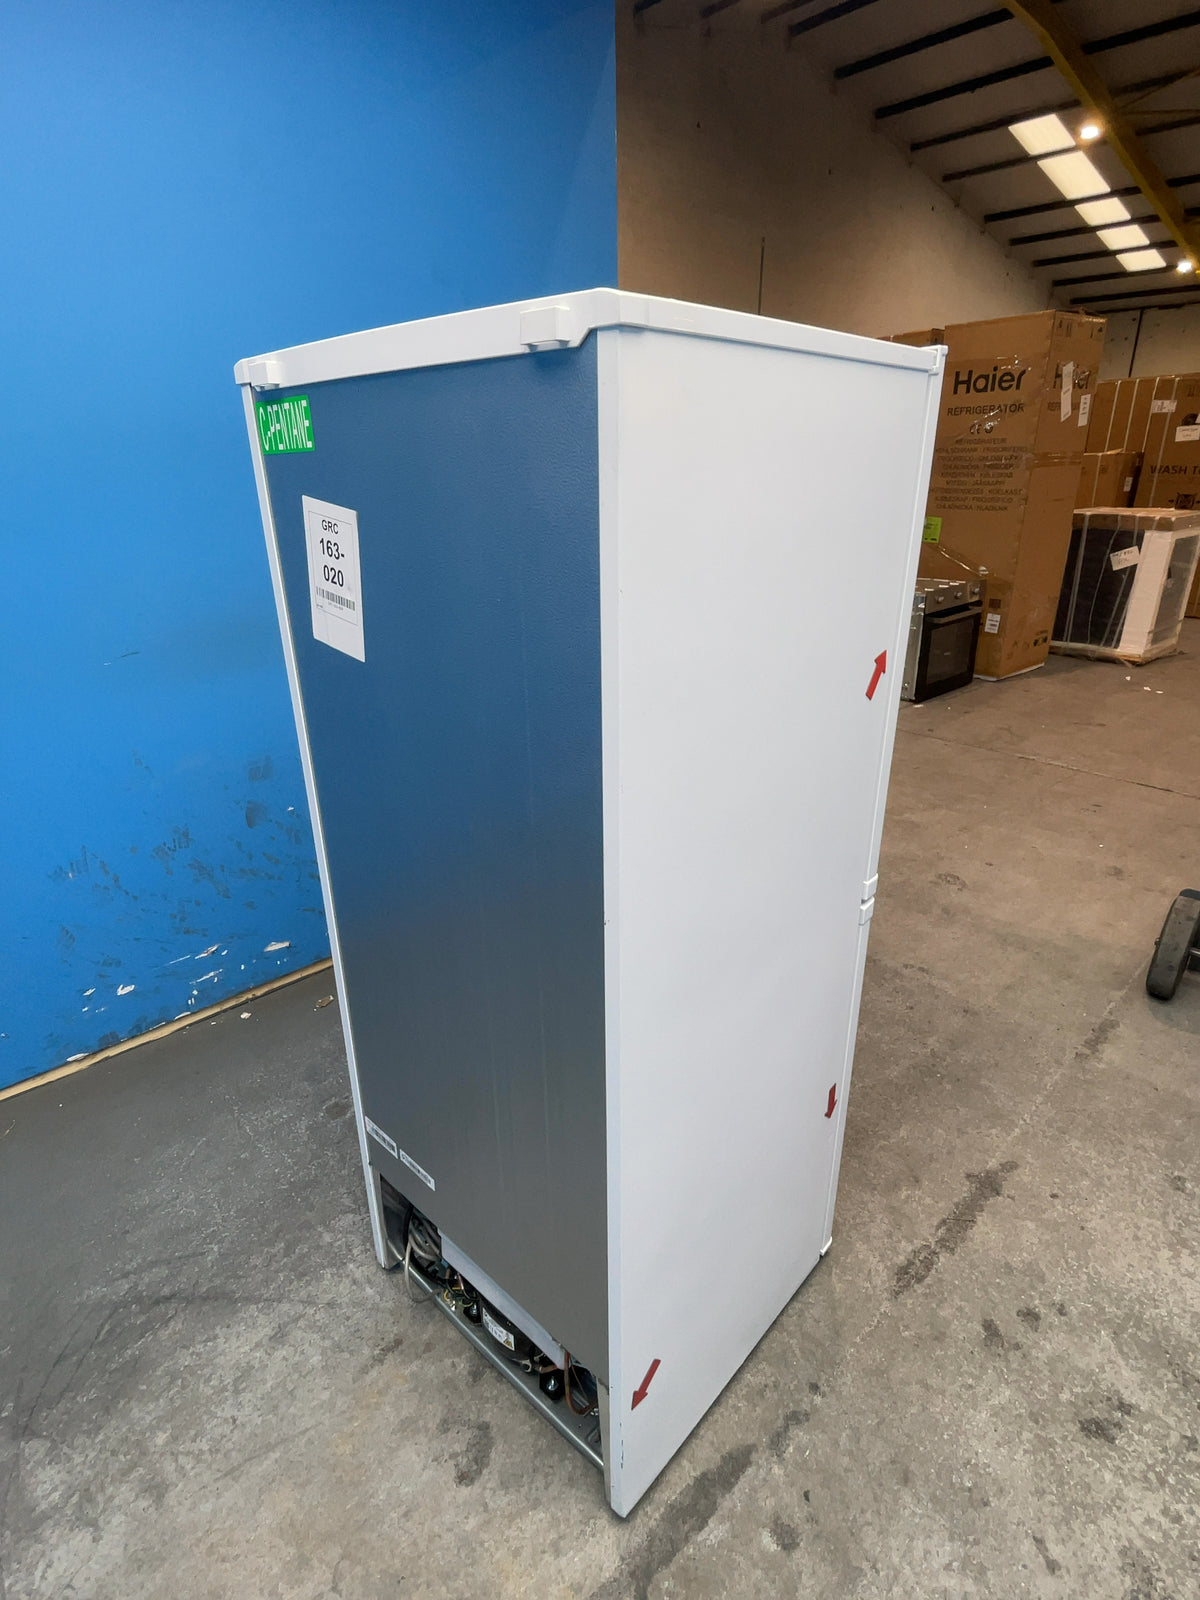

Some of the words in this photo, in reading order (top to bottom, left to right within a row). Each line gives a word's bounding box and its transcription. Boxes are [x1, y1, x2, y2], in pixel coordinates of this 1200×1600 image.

[953, 366, 1026, 395] Haier
[947, 402, 1025, 417] REFRIGERATOR
[259, 400, 313, 451] C-PENTANE
[1150, 465, 1187, 475] WASH
[321, 519, 339, 535] GRC
[319, 538, 345, 560] 163-
[323, 564, 344, 587] 020
